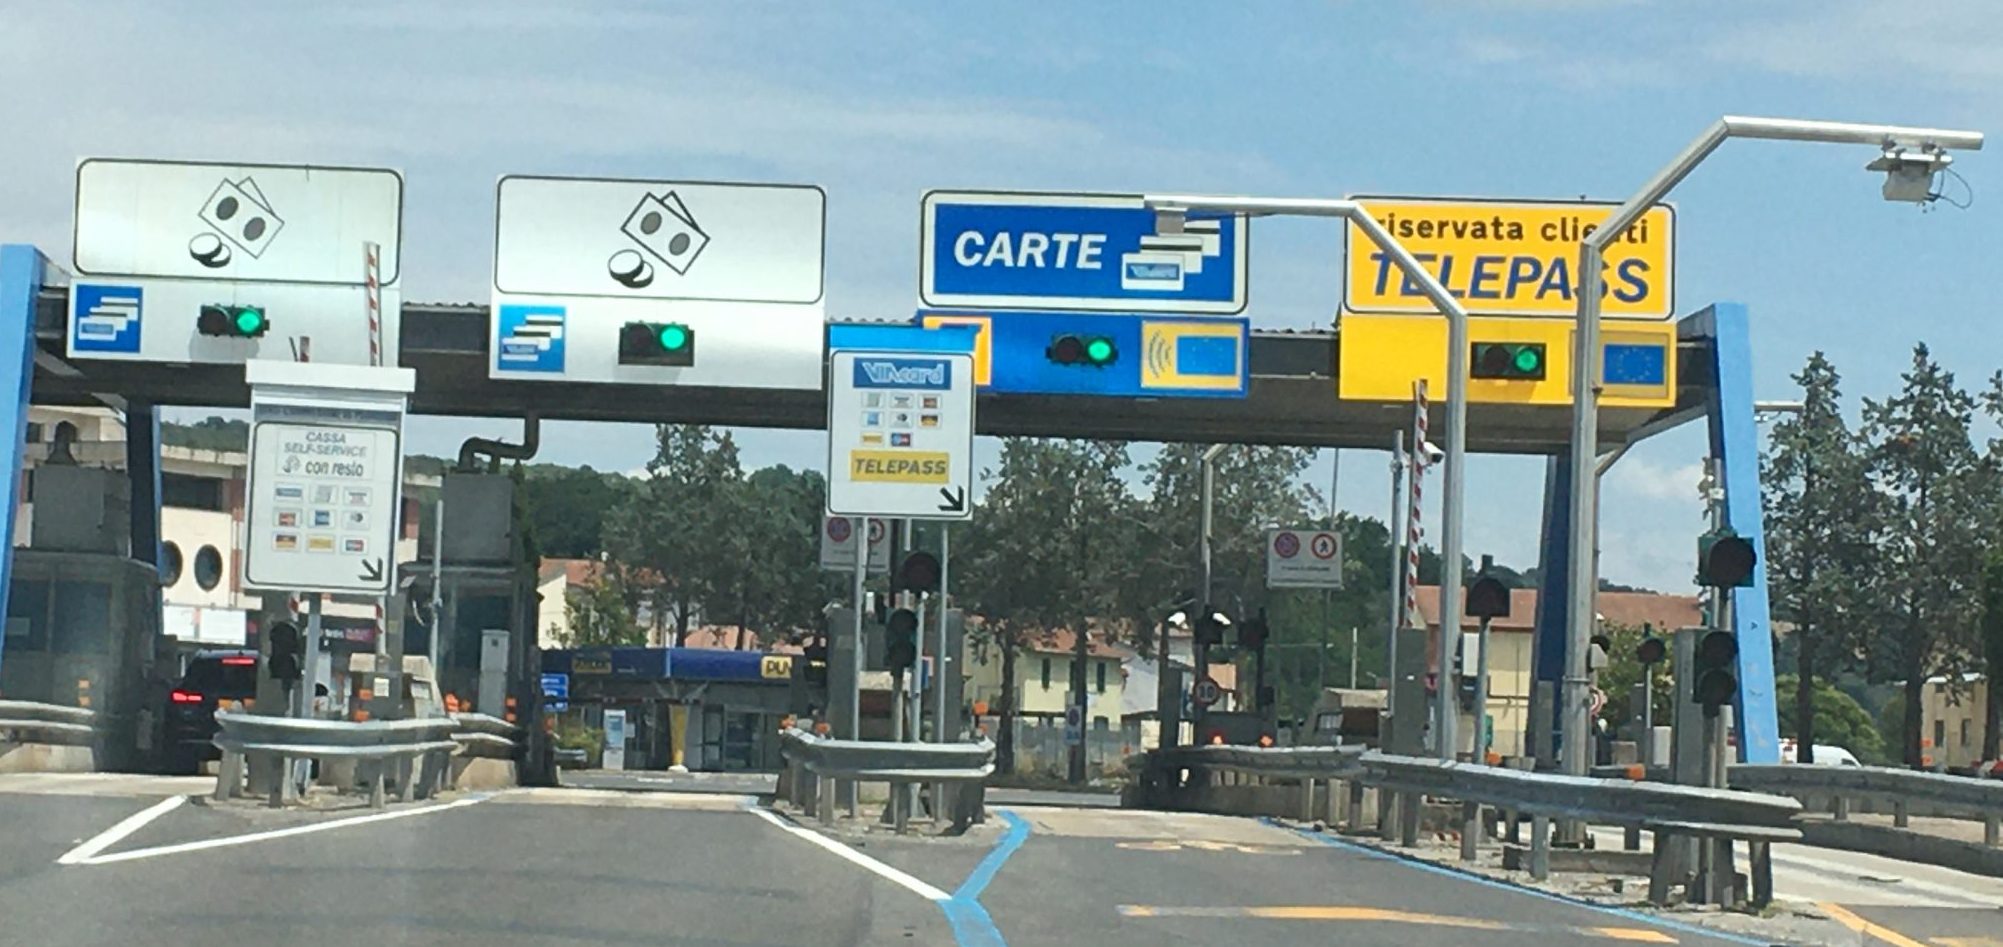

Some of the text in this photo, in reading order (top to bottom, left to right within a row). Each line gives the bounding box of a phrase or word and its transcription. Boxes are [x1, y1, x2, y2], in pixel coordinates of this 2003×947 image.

[1376, 213, 1648, 244] iservata clieti
[953, 230, 1107, 270] CARTE
[306, 432, 347, 444] CASSA
[284, 443, 368, 458] SELF-SERVICE
[305, 460, 364, 477] con resto
[855, 458, 947, 475] TELEPASS
